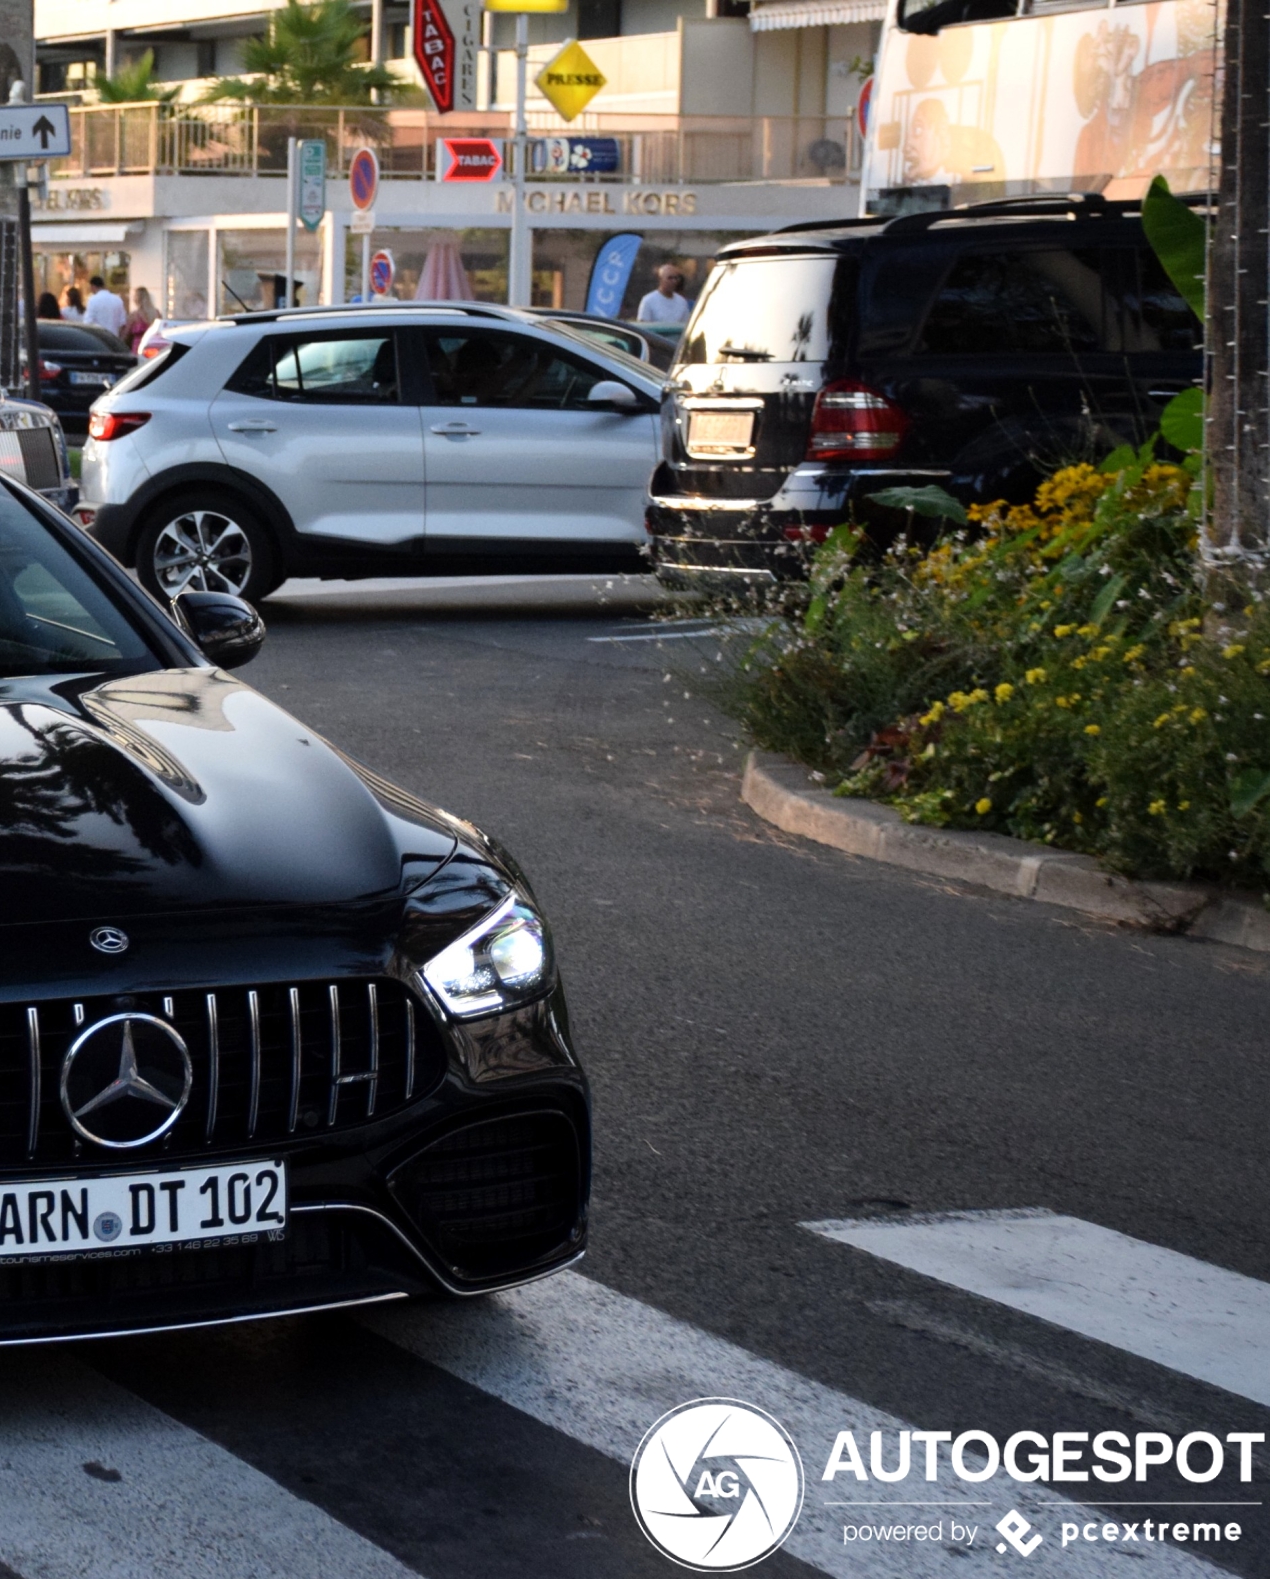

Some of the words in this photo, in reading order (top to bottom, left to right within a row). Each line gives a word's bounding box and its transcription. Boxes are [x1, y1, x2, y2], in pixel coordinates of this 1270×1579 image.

[422, 9, 447, 86] TABAC
[461, 4, 474, 105] CIGARES
[546, 72, 603, 87] PRESSE
[458, 154, 496, 167] TABAC
[624, 190, 698, 216] KORS
[128, 1180, 185, 1236] DT
[199, 1169, 280, 1229] 102
[151, 1244, 172, 1254] +33
[203, 1238, 220, 1248] 22
